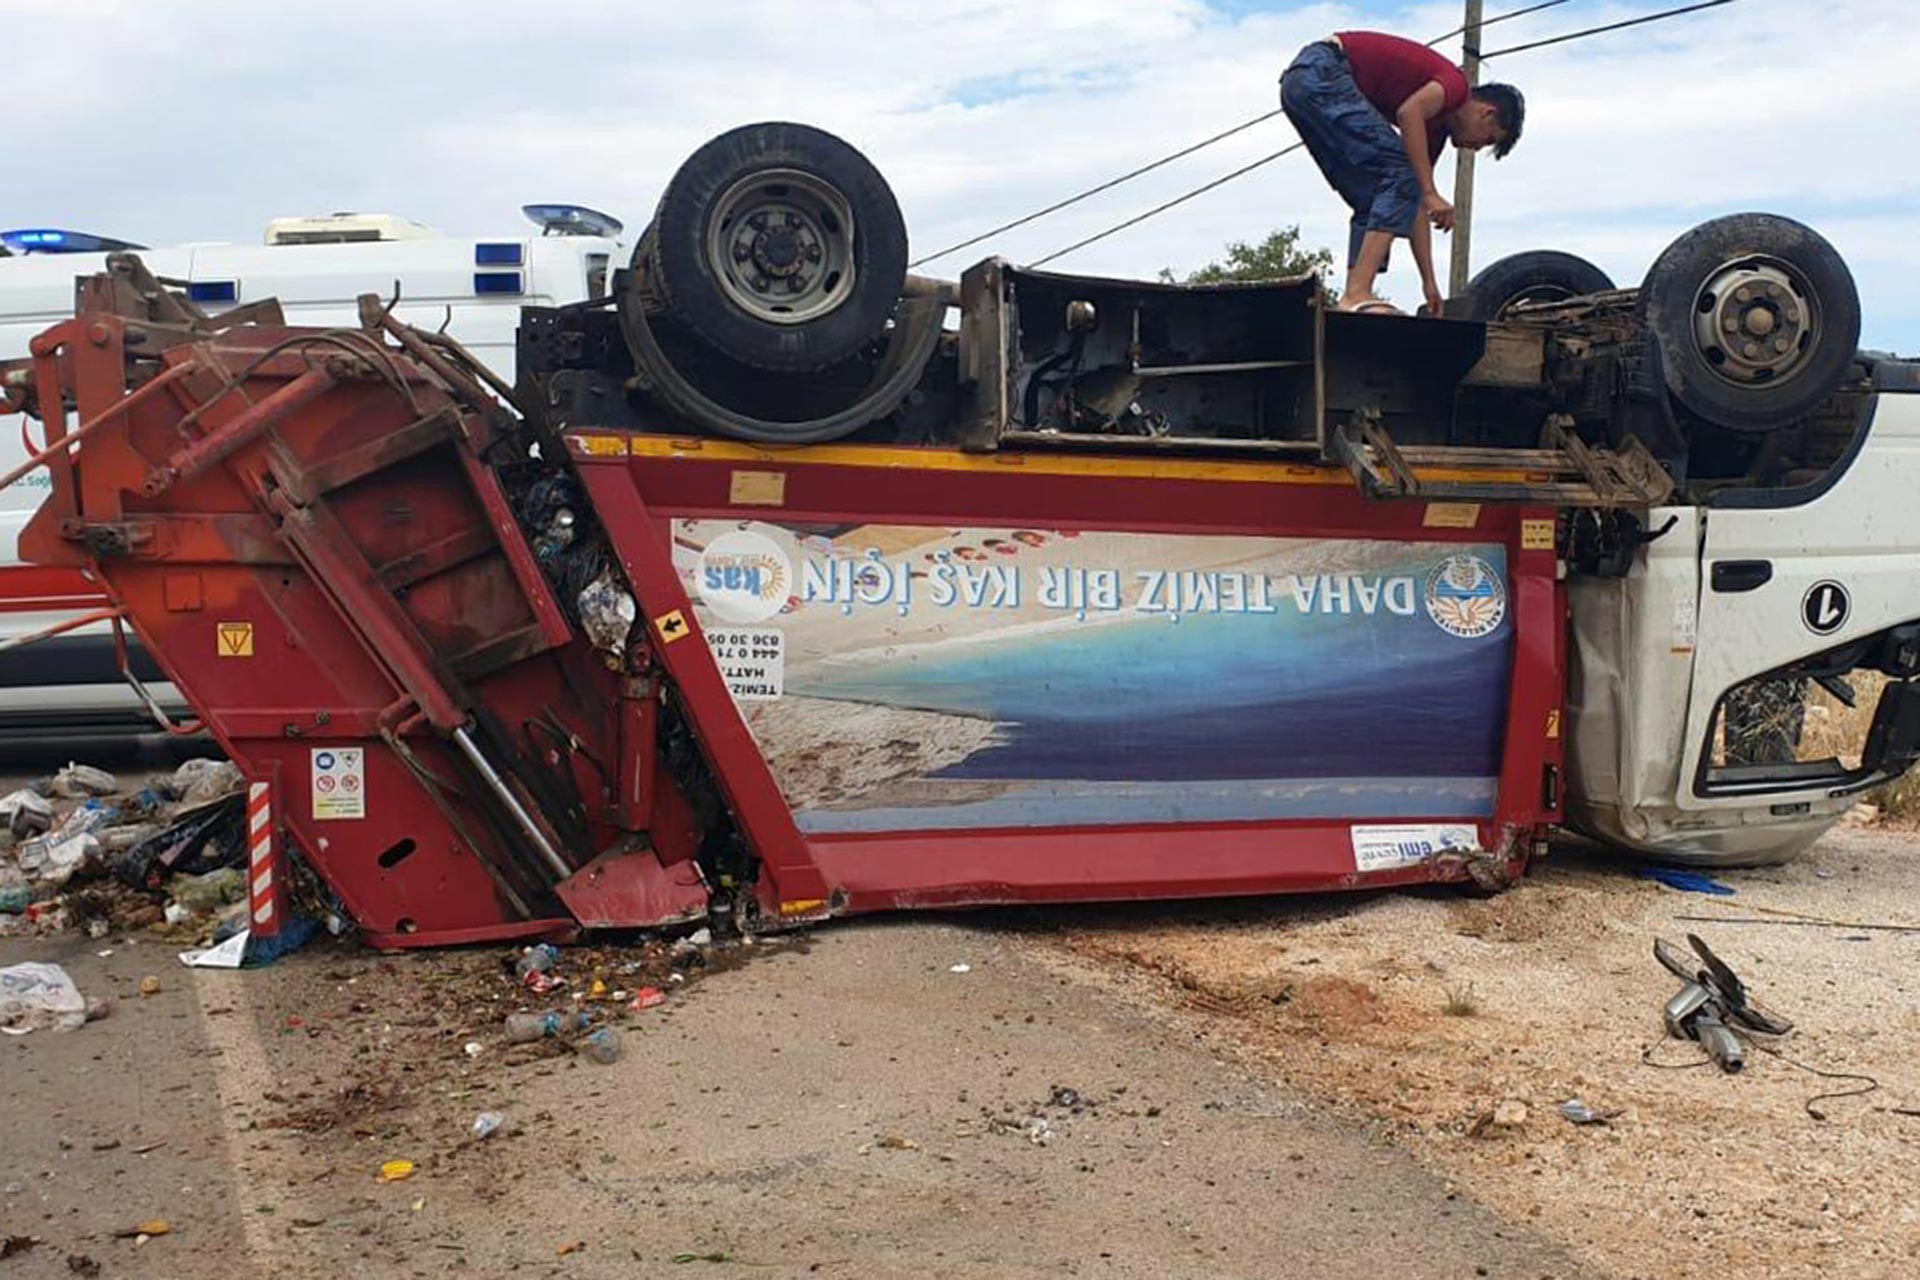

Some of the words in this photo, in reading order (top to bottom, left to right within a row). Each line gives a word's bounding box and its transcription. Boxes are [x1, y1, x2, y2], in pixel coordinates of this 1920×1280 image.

[801, 548, 914, 616] İÇİN
[929, 550, 1021, 608] KAŞ
[1037, 566, 1121, 622] BİR
[1135, 569, 1277, 623] TEMİZ
[1290, 574, 1416, 616] DAHA
[1817, 588, 1840, 625] 1
[730, 634, 748, 645] 30
[738, 648, 748, 658] 0
[752, 635, 780, 647] 836
[752, 649, 780, 660] 444
[729, 683, 777, 696] TEMİZ
